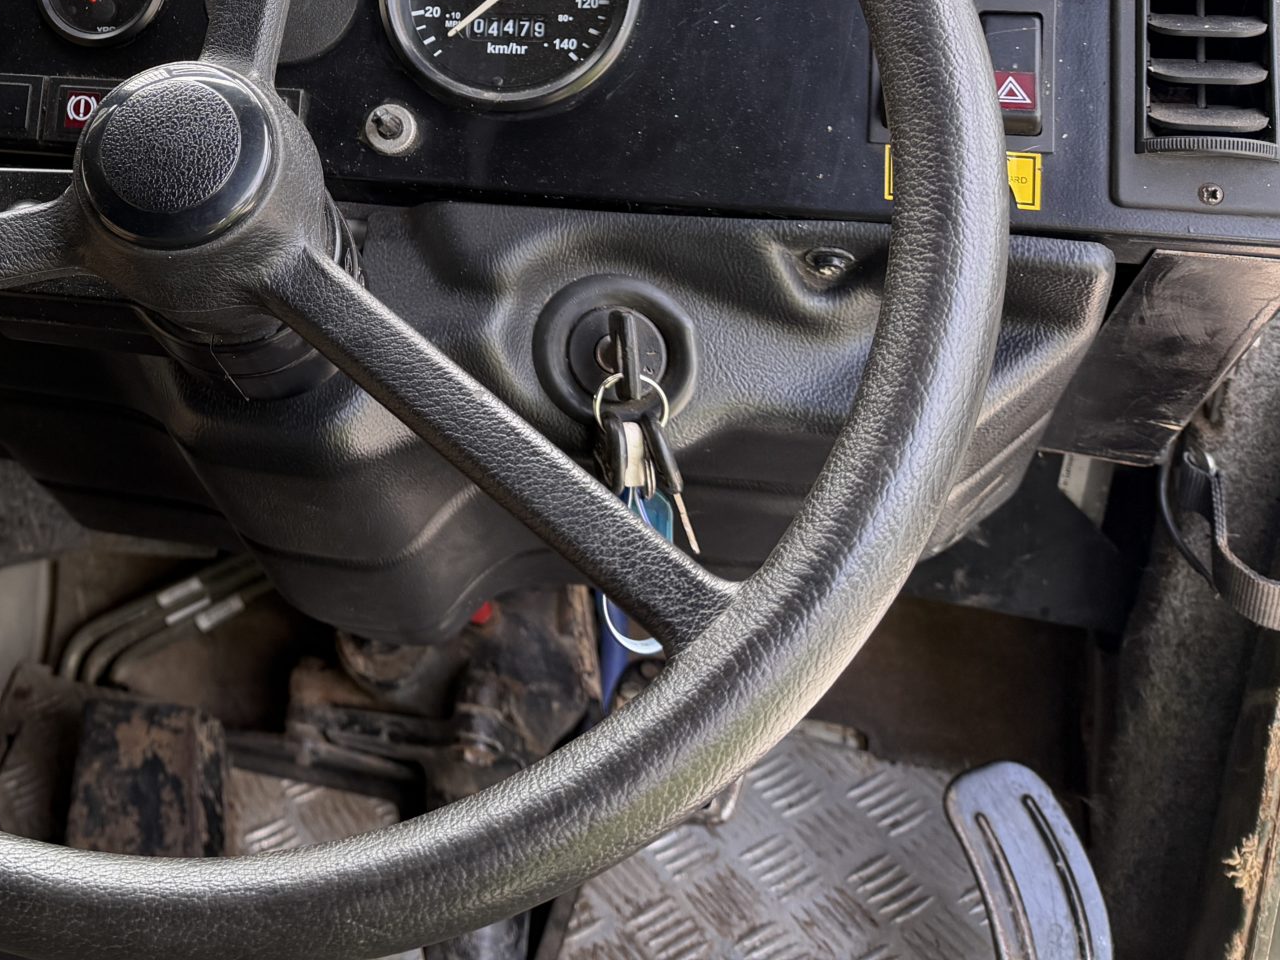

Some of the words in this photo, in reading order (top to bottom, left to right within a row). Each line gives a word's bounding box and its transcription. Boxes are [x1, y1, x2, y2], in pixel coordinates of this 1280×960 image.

[424, 6, 441, 18] 20
[451, 12, 461, 20] 10
[558, 14, 569, 22] 80
[487, 42, 528, 55] km/hr
[553, 39, 577, 50] 140
